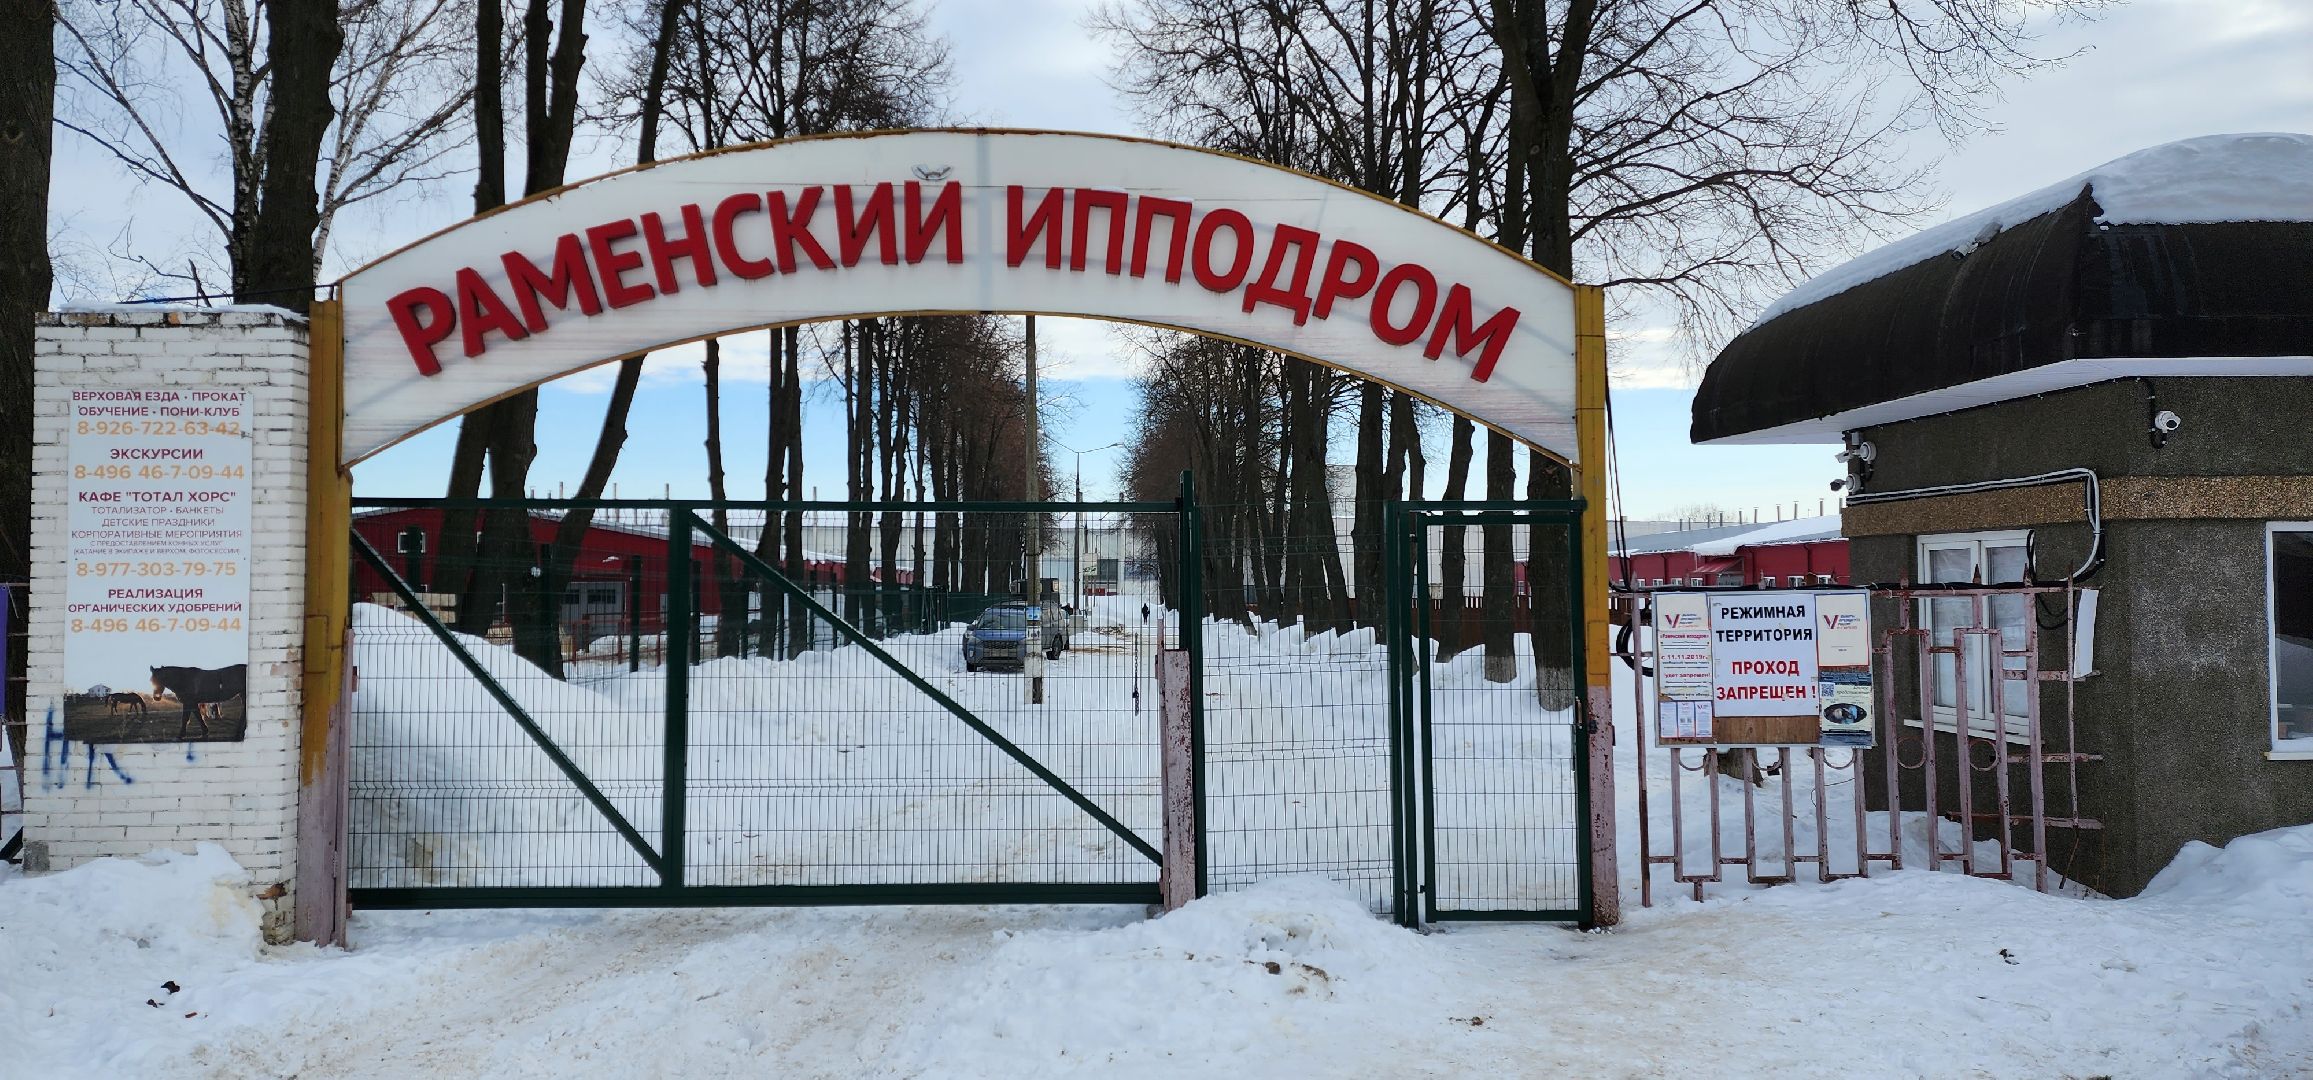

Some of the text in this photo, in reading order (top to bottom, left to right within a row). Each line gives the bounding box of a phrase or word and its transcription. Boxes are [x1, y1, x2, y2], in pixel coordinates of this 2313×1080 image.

[1006, 184, 1521, 384] ИППОДРОМ
[72, 391, 247, 402] ВЕРХОВАЯ ЕЗДА ПРОКАТ
[78, 407, 240, 417] ОБУЧЕНИЕ ПОНИ-КЛУБ
[77, 421, 240, 436] 8-926-722-63-42
[110, 448, 203, 460] ЭКСКУРСИИ
[74, 465, 245, 479] 8-496 46-7-09-44
[79, 491, 236, 502] КАФЕ "ТОТАЛ ХОРС"
[91, 506, 224, 514] ТОТАЛИЗАТОР БАНКЕТЫ
[101, 518, 215, 528] ДЕТСКИЕ ПРАЗДНИКИ
[71, 530, 242, 539] КОРПОРАТИВНЫЕ МЕРОПРИЯТИЯ
[75, 562, 237, 577] 8-977-303-79-75
[108, 588, 203, 600] РЕАЛИЗАЦИЯ
[68, 601, 242, 614] ОРГАНИЧЕСКИХ УДОБРЕНИЙ
[1721, 605, 1806, 619] РЕЖИМНАЯ
[71, 618, 242, 632] 8-496 46-7-09-44
[1716, 629, 1812, 642] ТЕРРИТОРИЯ
[1732, 661, 1800, 676] ПРОХОД
[1717, 686, 1806, 701] ЗАПРЕЩЕН
